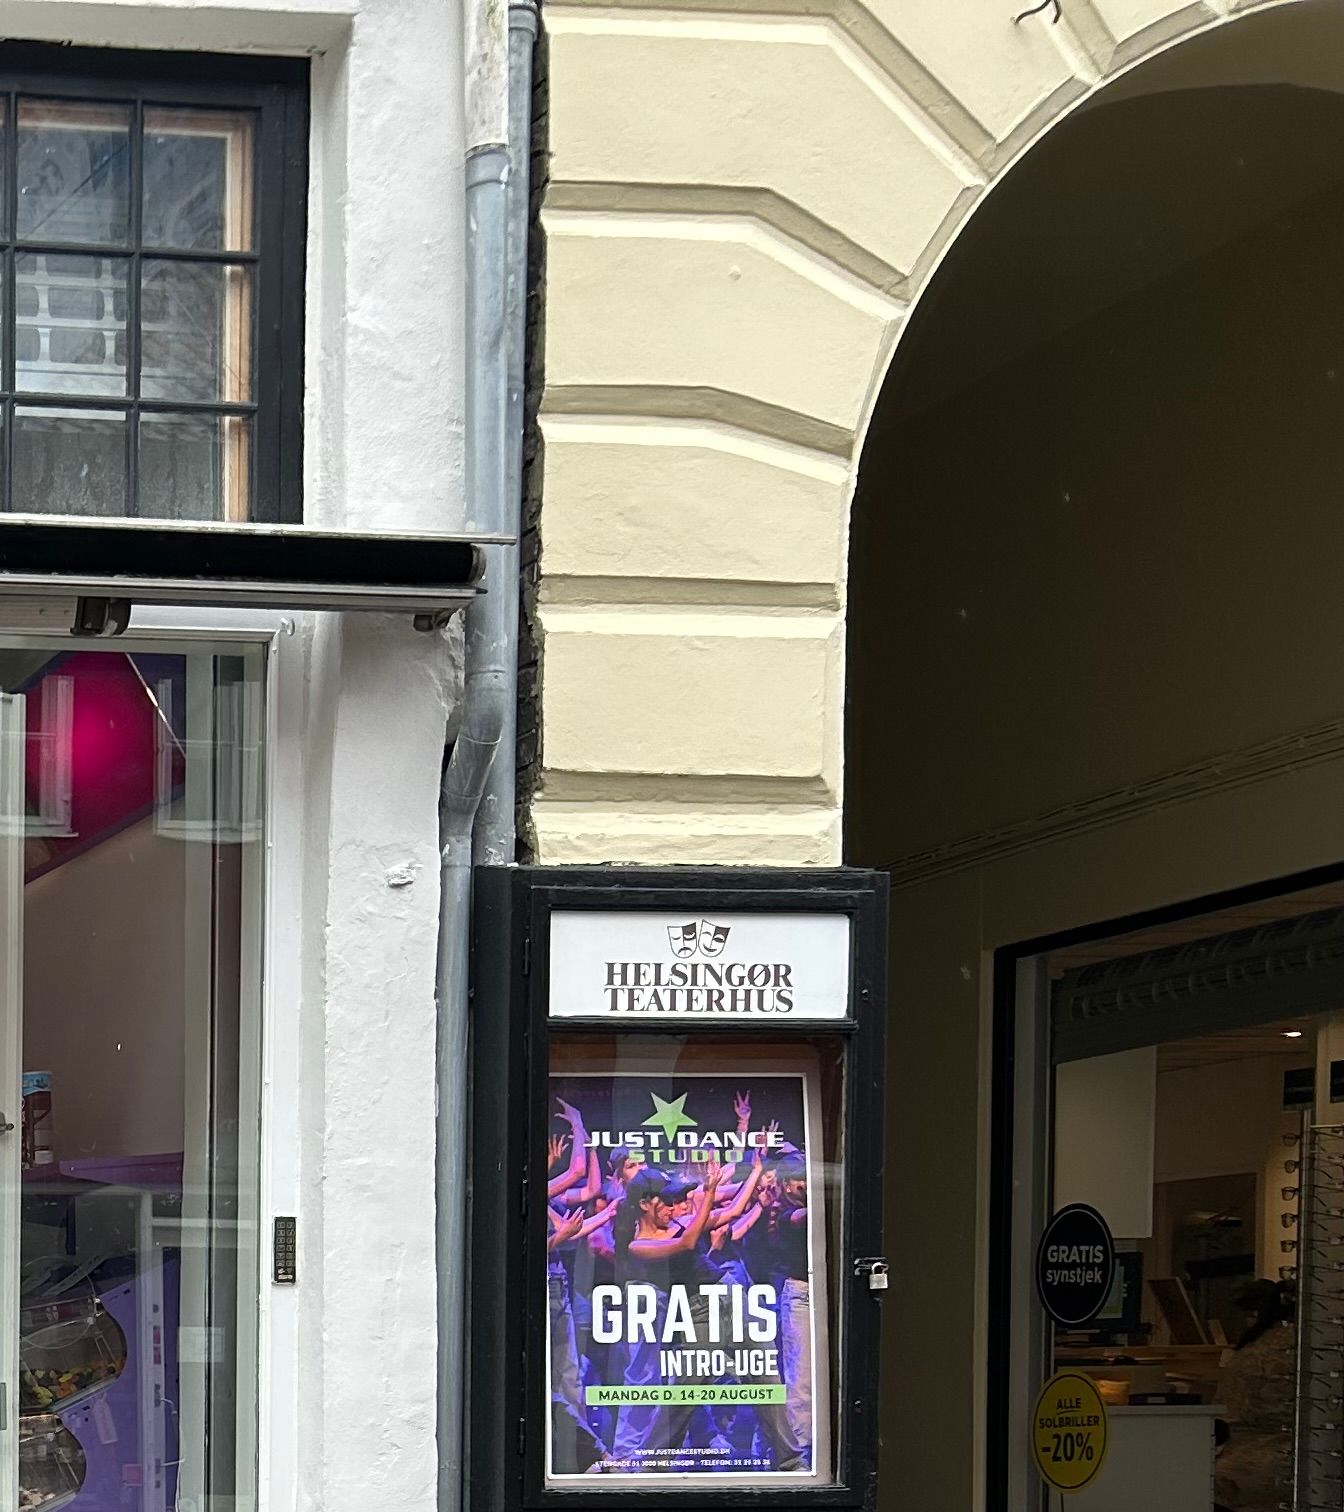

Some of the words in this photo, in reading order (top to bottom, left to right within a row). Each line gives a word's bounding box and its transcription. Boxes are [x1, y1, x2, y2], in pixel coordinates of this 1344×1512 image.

[604, 962, 794, 988] HELSINGØR
[604, 987, 794, 1013] TEATERHUS
[583, 1131, 665, 1148] JUST
[676, 1131, 786, 1149] DANCE
[628, 1148, 744, 1164] STUDIO
[1047, 1244, 1105, 1265] GRATIS
[1045, 1267, 1104, 1287] synstjek
[591, 1284, 778, 1345] GRATIS
[659, 1349, 779, 1378] INTRO-UGE
[598, 1388, 659, 1401] MANDAG
[679, 1388, 716, 1401] 14-20
[718, 1388, 774, 1401] AUGUST
[1056, 1397, 1081, 1410] ALLE
[1038, 1414, 1100, 1429] SOLBRILLER
[1041, 1432, 1094, 1463] -20%
